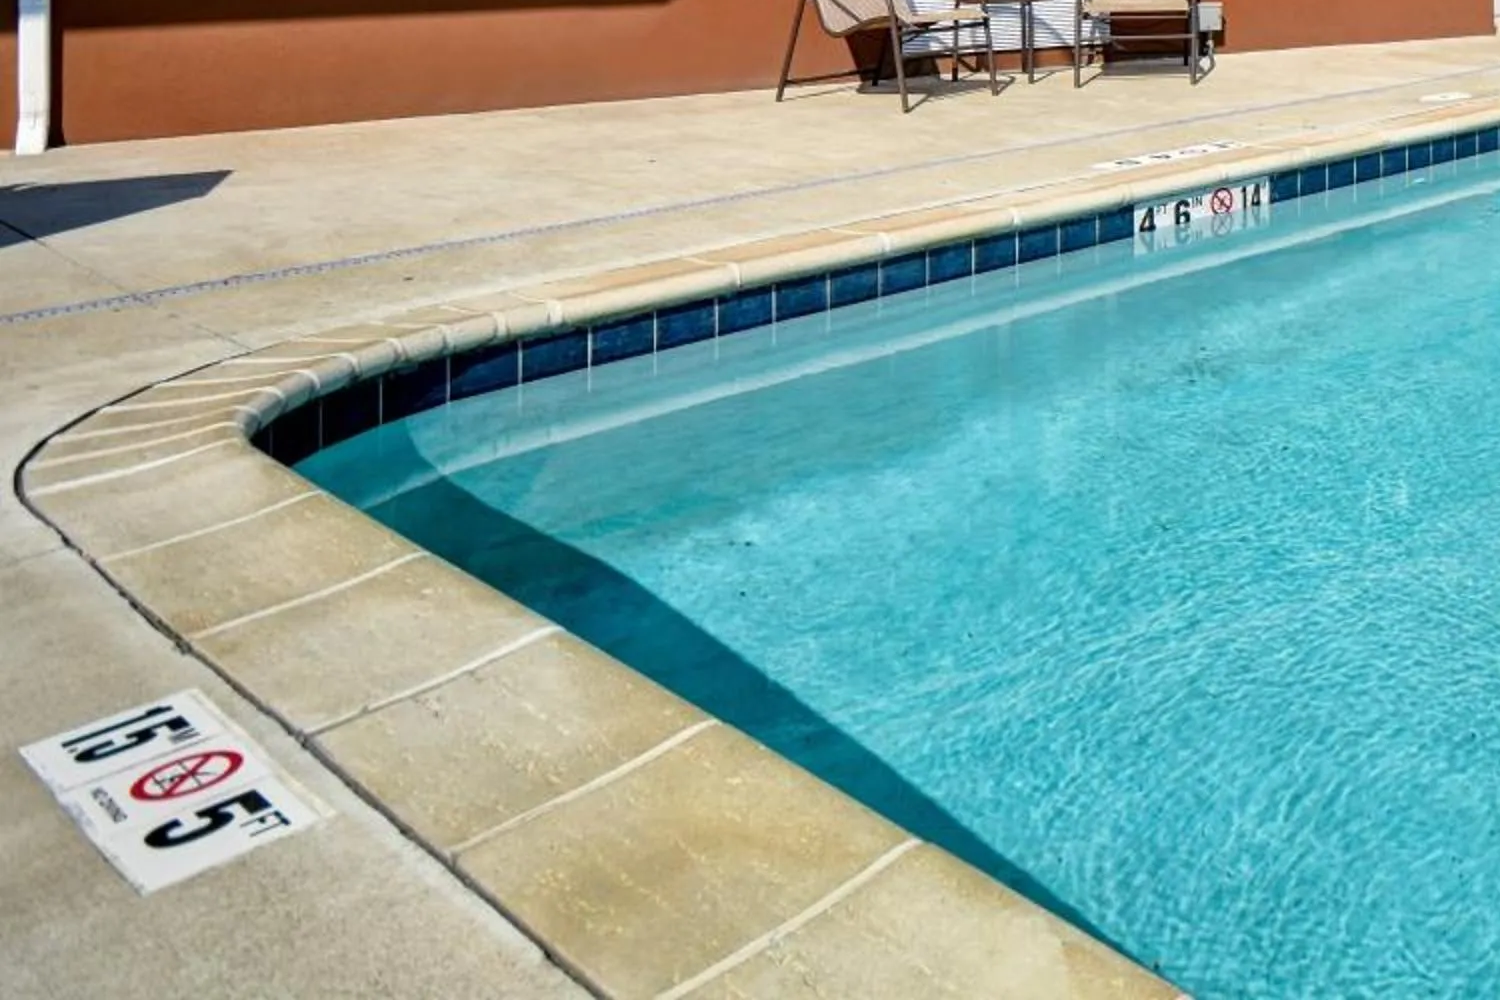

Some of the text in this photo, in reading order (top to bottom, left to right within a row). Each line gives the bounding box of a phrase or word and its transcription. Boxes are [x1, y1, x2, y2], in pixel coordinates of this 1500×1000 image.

[1139, 206, 1156, 233] 4
[1174, 199, 1191, 225] 6
[143, 788, 273, 850] 5
[239, 808, 293, 838] FT
